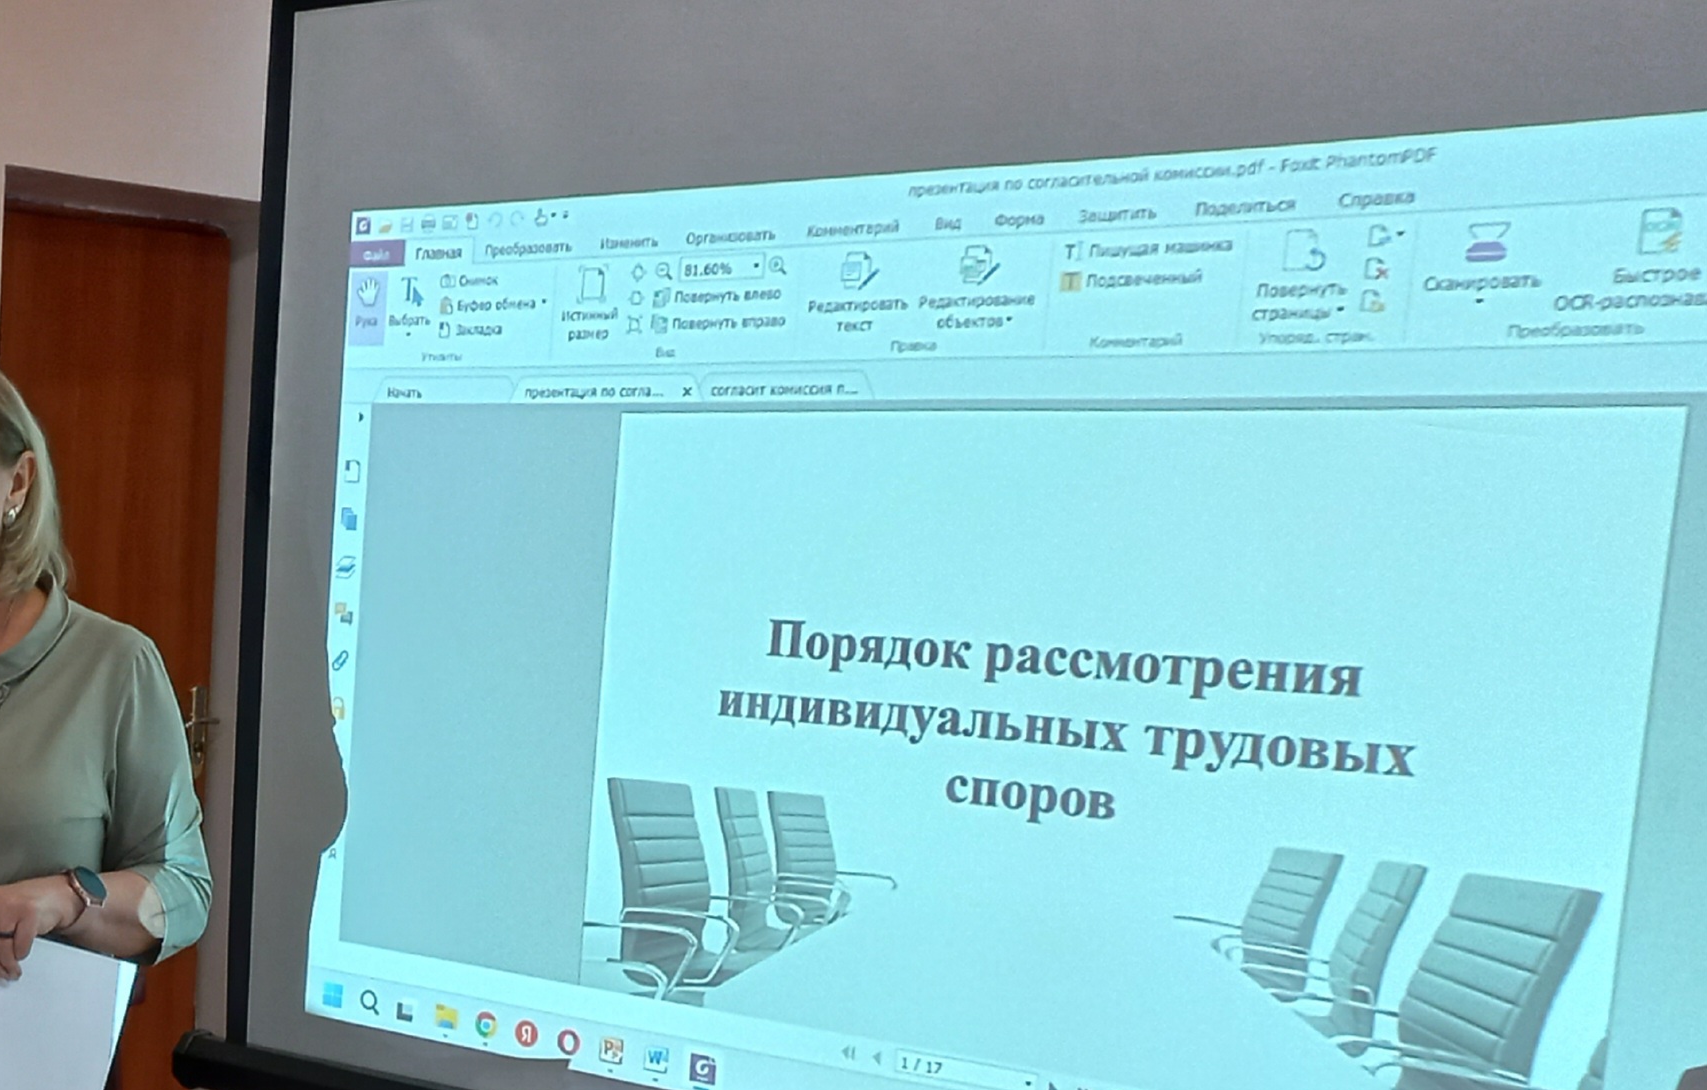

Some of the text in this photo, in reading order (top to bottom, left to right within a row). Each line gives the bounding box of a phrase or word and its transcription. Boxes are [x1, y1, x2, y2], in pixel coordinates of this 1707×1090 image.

[908, 181, 1000, 198] презентация
[1004, 180, 1023, 191] по
[1195, 199, 1296, 217] Поделиться
[1339, 192, 1415, 210] Справка
[935, 217, 962, 231] Вид
[995, 213, 1045, 229] Форма
[1079, 208, 1156, 224] Защитить
[807, 219, 899, 237] Комментарий
[415, 247, 462, 261] Главная
[485, 242, 572, 257] Преобразовать
[684, 262, 732, 276] 81.60%
[1612, 267, 1701, 283] Быстрое
[1086, 269, 1202, 288] Подсвеченный
[1424, 274, 1542, 291] Сканировать
[674, 291, 739, 304] Повернуть
[1256, 282, 1348, 299] Повернуть
[808, 297, 908, 313] Редактировать
[918, 294, 1035, 310] Редактирование
[936, 314, 1004, 329] объектов
[1252, 306, 1331, 321] страницы
[672, 317, 737, 331] Повернуть
[836, 320, 873, 332] текст
[1507, 321, 1645, 338] Преобразовать
[525, 386, 597, 400] презентация
[601, 387, 615, 397] по
[766, 618, 1364, 699] Порядок рассмотрения
[718, 687, 1417, 778] индивидуальных трудовых
[945, 774, 1116, 823] споров
